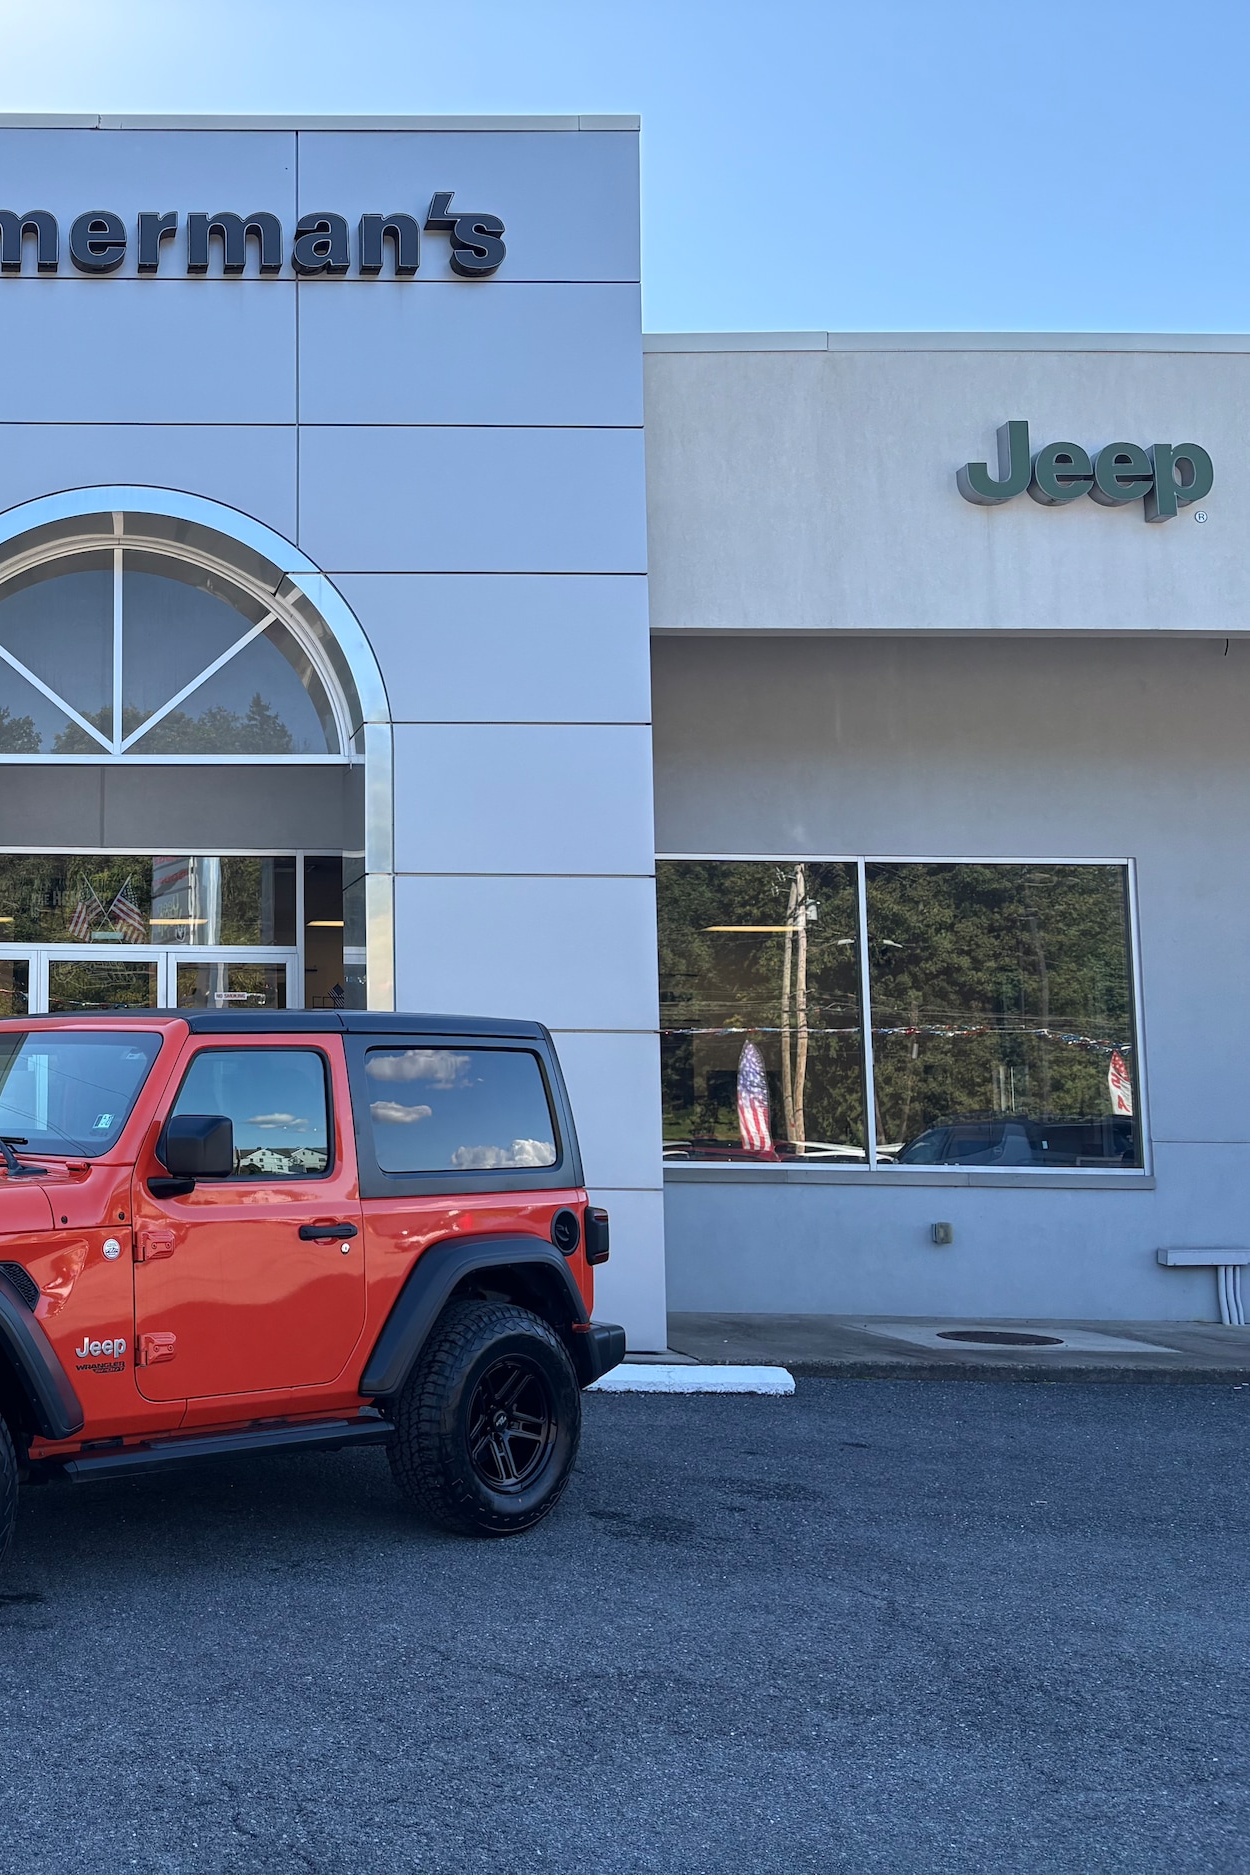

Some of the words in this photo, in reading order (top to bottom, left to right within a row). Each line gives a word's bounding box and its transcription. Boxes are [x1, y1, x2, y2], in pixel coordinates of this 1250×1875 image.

[956, 420, 1214, 523] Jeep
[75, 1336, 127, 1359] Jeep
[75, 1361, 125, 1371] WRANGLER
